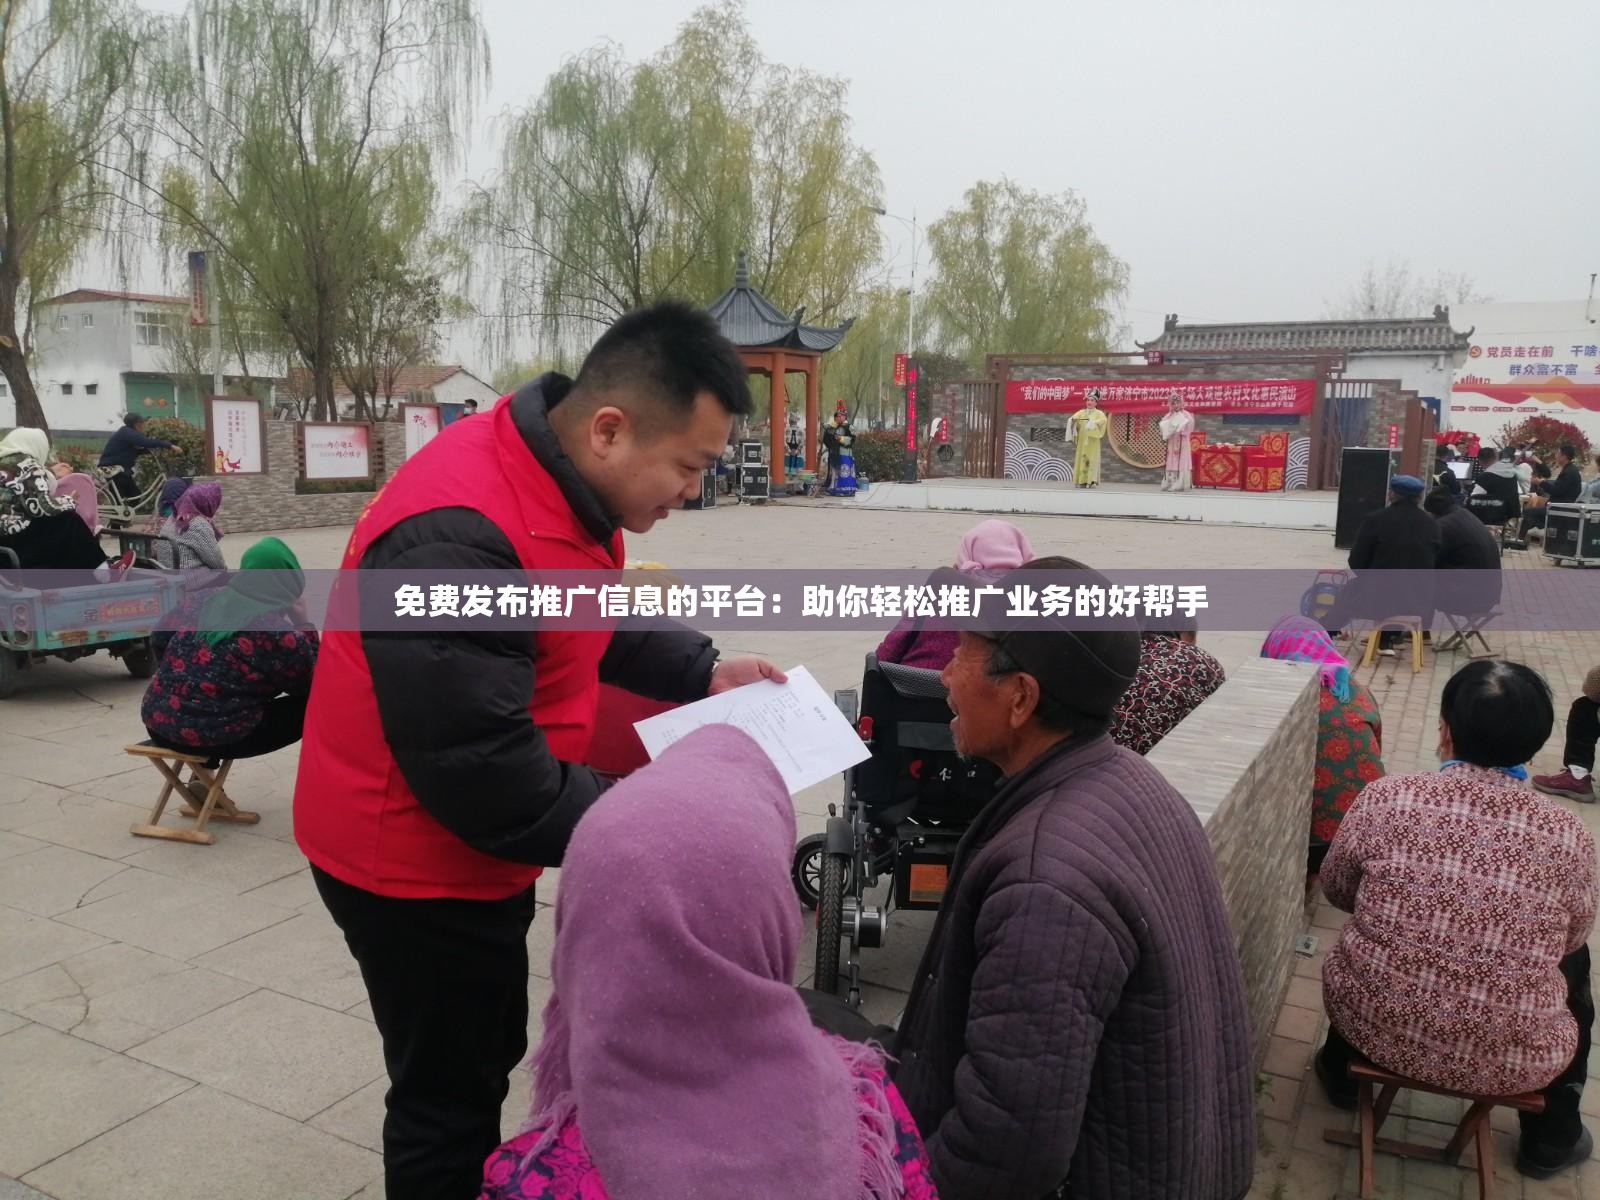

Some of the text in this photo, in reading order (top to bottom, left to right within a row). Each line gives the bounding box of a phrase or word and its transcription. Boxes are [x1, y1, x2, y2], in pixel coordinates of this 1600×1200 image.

[1487, 345, 1600, 358] 党员走在前 干啥
[1509, 363, 1578, 376] 群众富不富
